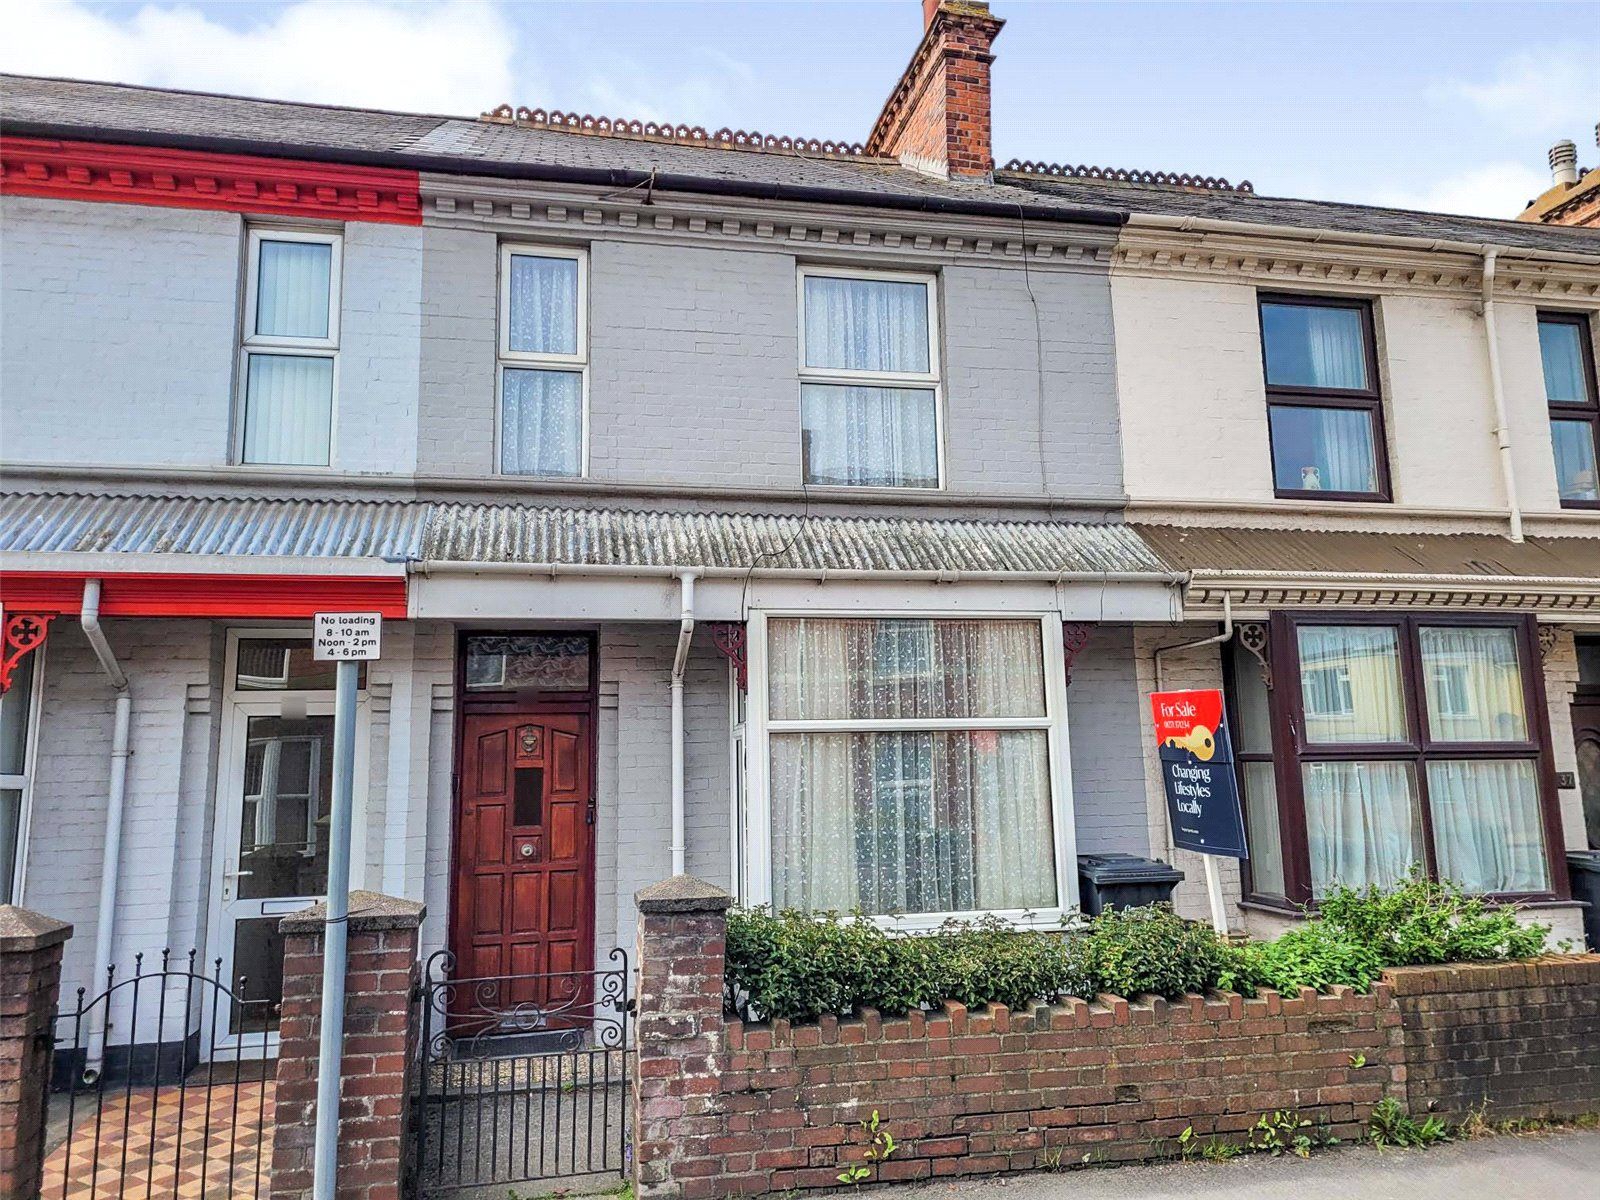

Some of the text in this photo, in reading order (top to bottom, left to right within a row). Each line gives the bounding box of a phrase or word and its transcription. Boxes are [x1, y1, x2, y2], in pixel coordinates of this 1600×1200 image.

[321, 616, 375, 625] No loading
[361, 639, 376, 647] pm
[351, 649, 366, 657] pm
[1160, 701, 1197, 717] For Sale
[1172, 763, 1211, 783] Changing
[1174, 781, 1211, 800] Lifestyles
[1177, 799, 1202, 818] Locally
